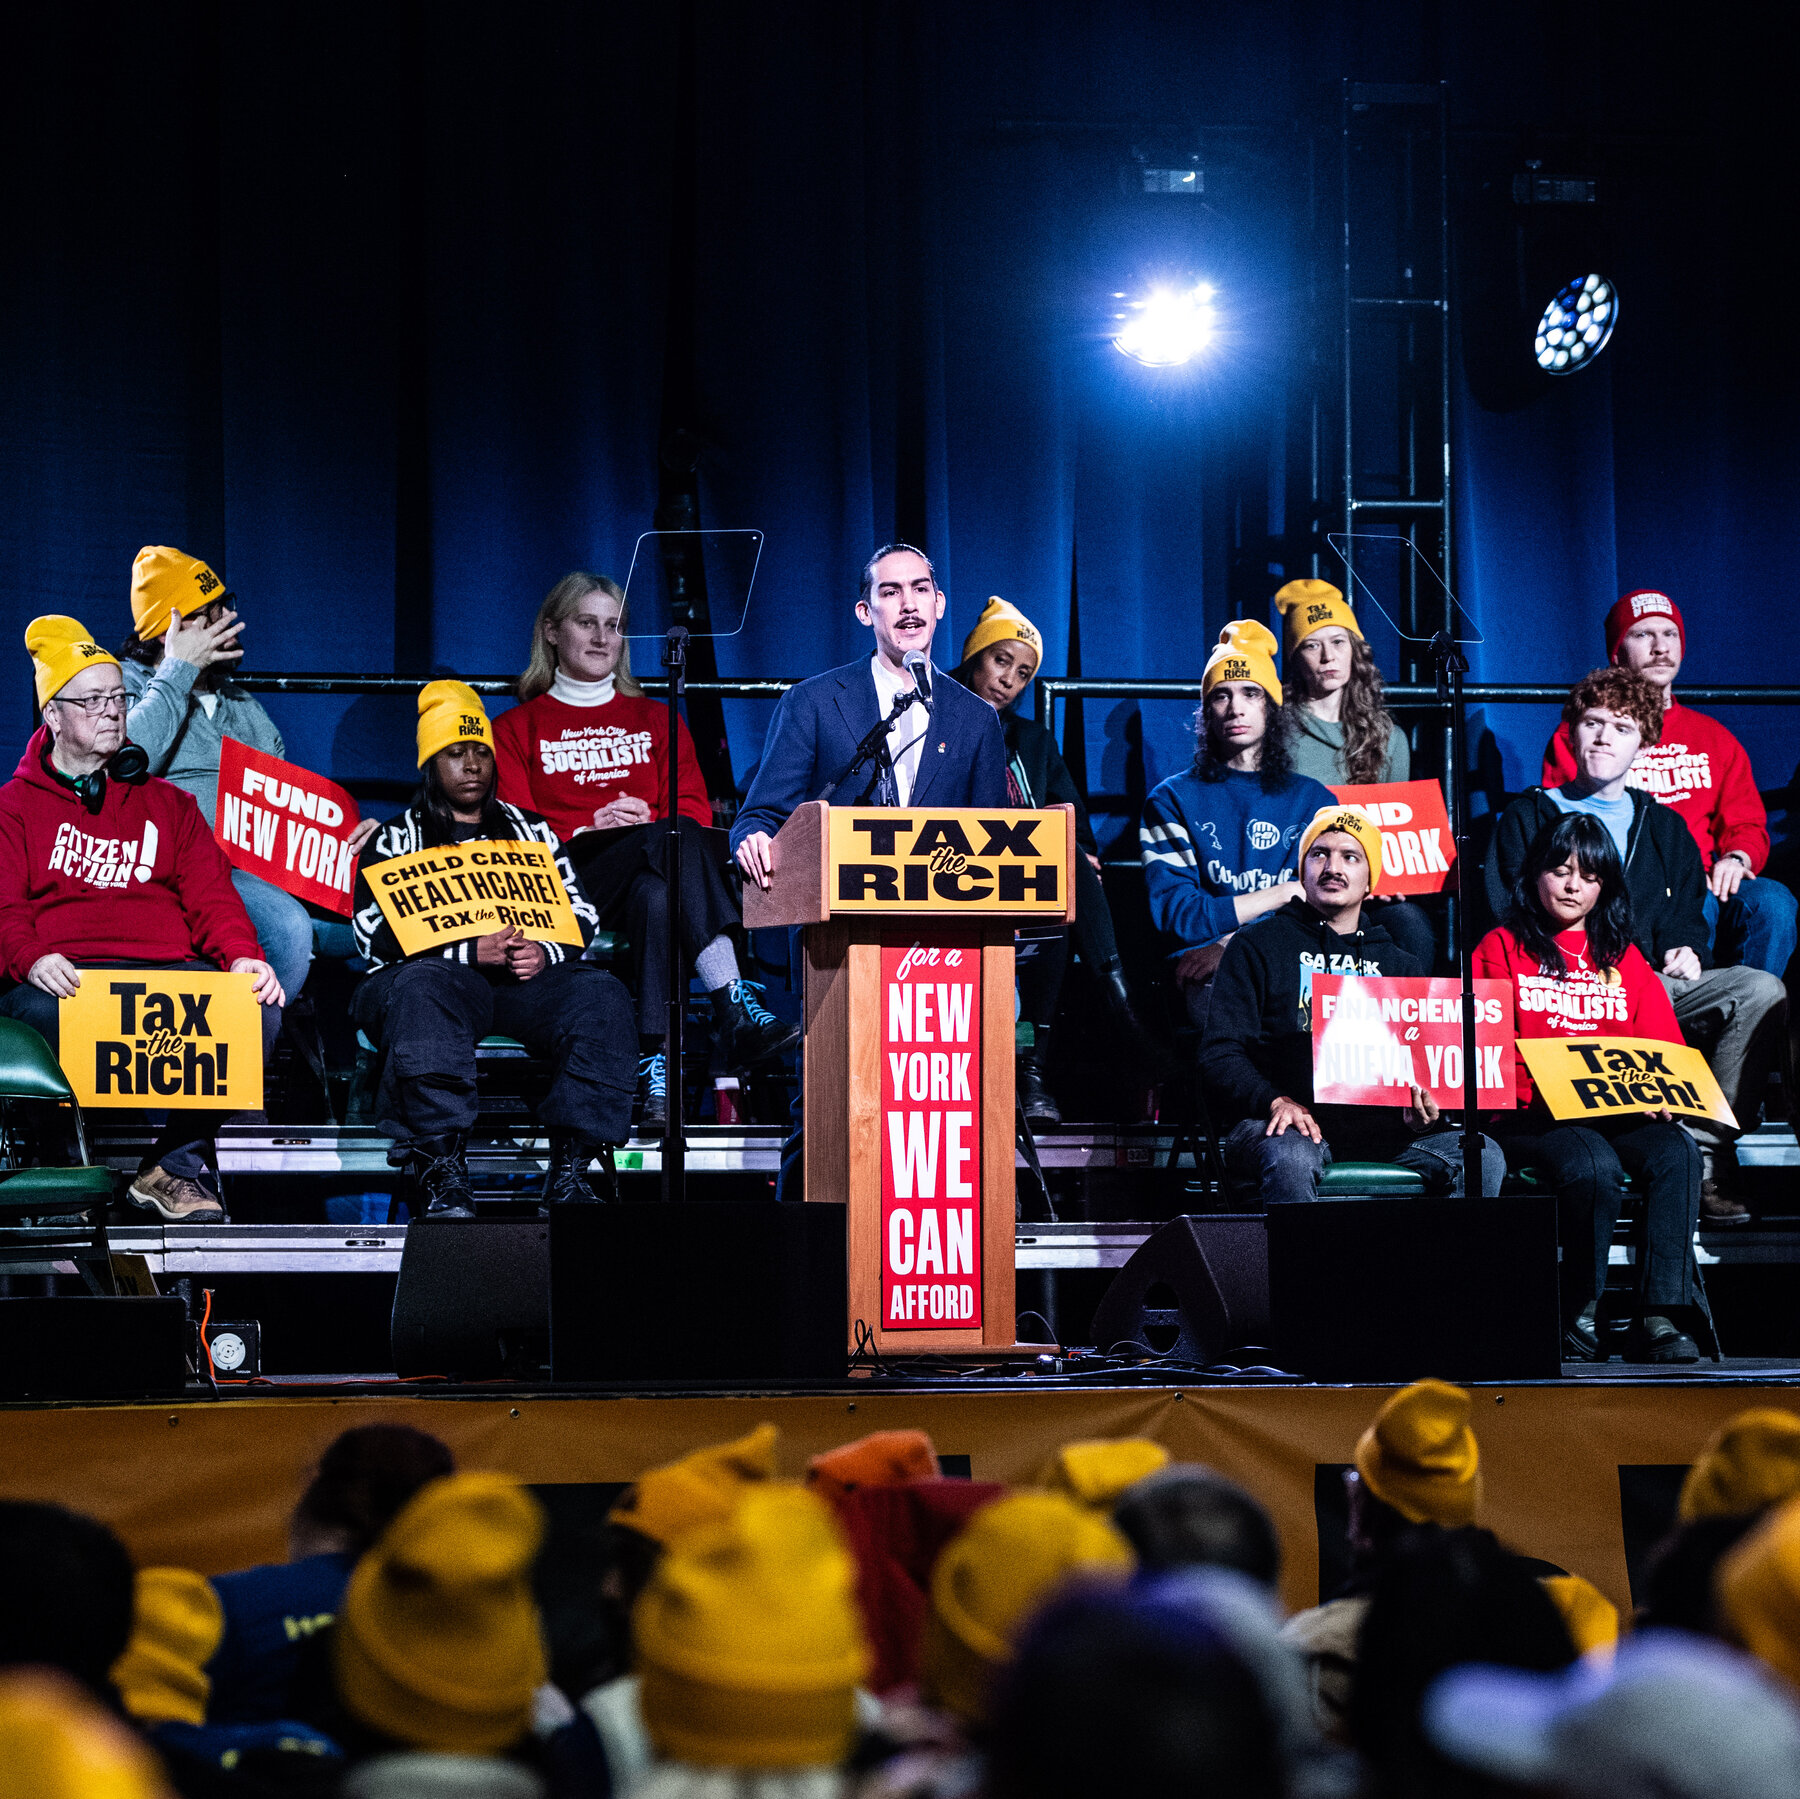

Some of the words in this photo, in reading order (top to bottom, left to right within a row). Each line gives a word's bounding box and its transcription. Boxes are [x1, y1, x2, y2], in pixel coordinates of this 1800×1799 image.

[1307, 603, 1326, 613] Tax
[1224, 669, 1250, 680] Rich!
[1226, 659, 1247, 669] Tax
[459, 715, 480, 725] Tax
[561, 729, 584, 740] New
[583, 726, 606, 737] York
[606, 726, 627, 737] City
[540, 731, 652, 752] DEMOCRATIC
[573, 771, 586, 785] of
[587, 768, 630, 782] America
[1625, 765, 1712, 793] OCIALISTS
[1630, 753, 1709, 771] MOCRATIC
[242, 767, 344, 828] FUND
[55, 823, 139, 863] CITIZEN
[222, 792, 280, 862] NEW
[285, 819, 354, 894] YORK
[853, 819, 1042, 857] TAX
[1381, 828, 1450, 877] ORK
[381, 855, 464, 886] CHILD
[471, 852, 547, 868] CARE!
[929, 846, 967, 874] the
[388, 871, 561, 919] HEALTHCARE!
[838, 864, 1058, 902] RICH
[422, 910, 477, 933] Tax
[475, 908, 496, 922] the
[497, 905, 555, 929] Rich!
[896, 941, 940, 980] for
[944, 949, 963, 967] a
[1518, 973, 1627, 998] DEMOCRATIC
[110, 982, 213, 1036] Tax
[888, 983, 973, 1043] NEW
[1519, 987, 1629, 1021] SOCIALISTS
[1404, 1026, 1420, 1041] a
[1546, 1015, 1561, 1029] of
[1560, 1017, 1598, 1031] America
[148, 1029, 184, 1056] the
[1566, 1043, 1675, 1076] Tax
[95, 1040, 229, 1096] Rich!
[888, 1052, 972, 1101] YORK
[1325, 1042, 1417, 1088] NUEVA
[1620, 1068, 1654, 1083] the
[1571, 1075, 1707, 1112] Rich!
[887, 1111, 973, 1198] WE
[888, 1208, 973, 1275] CAN
[890, 1284, 974, 1320] AFFORD
